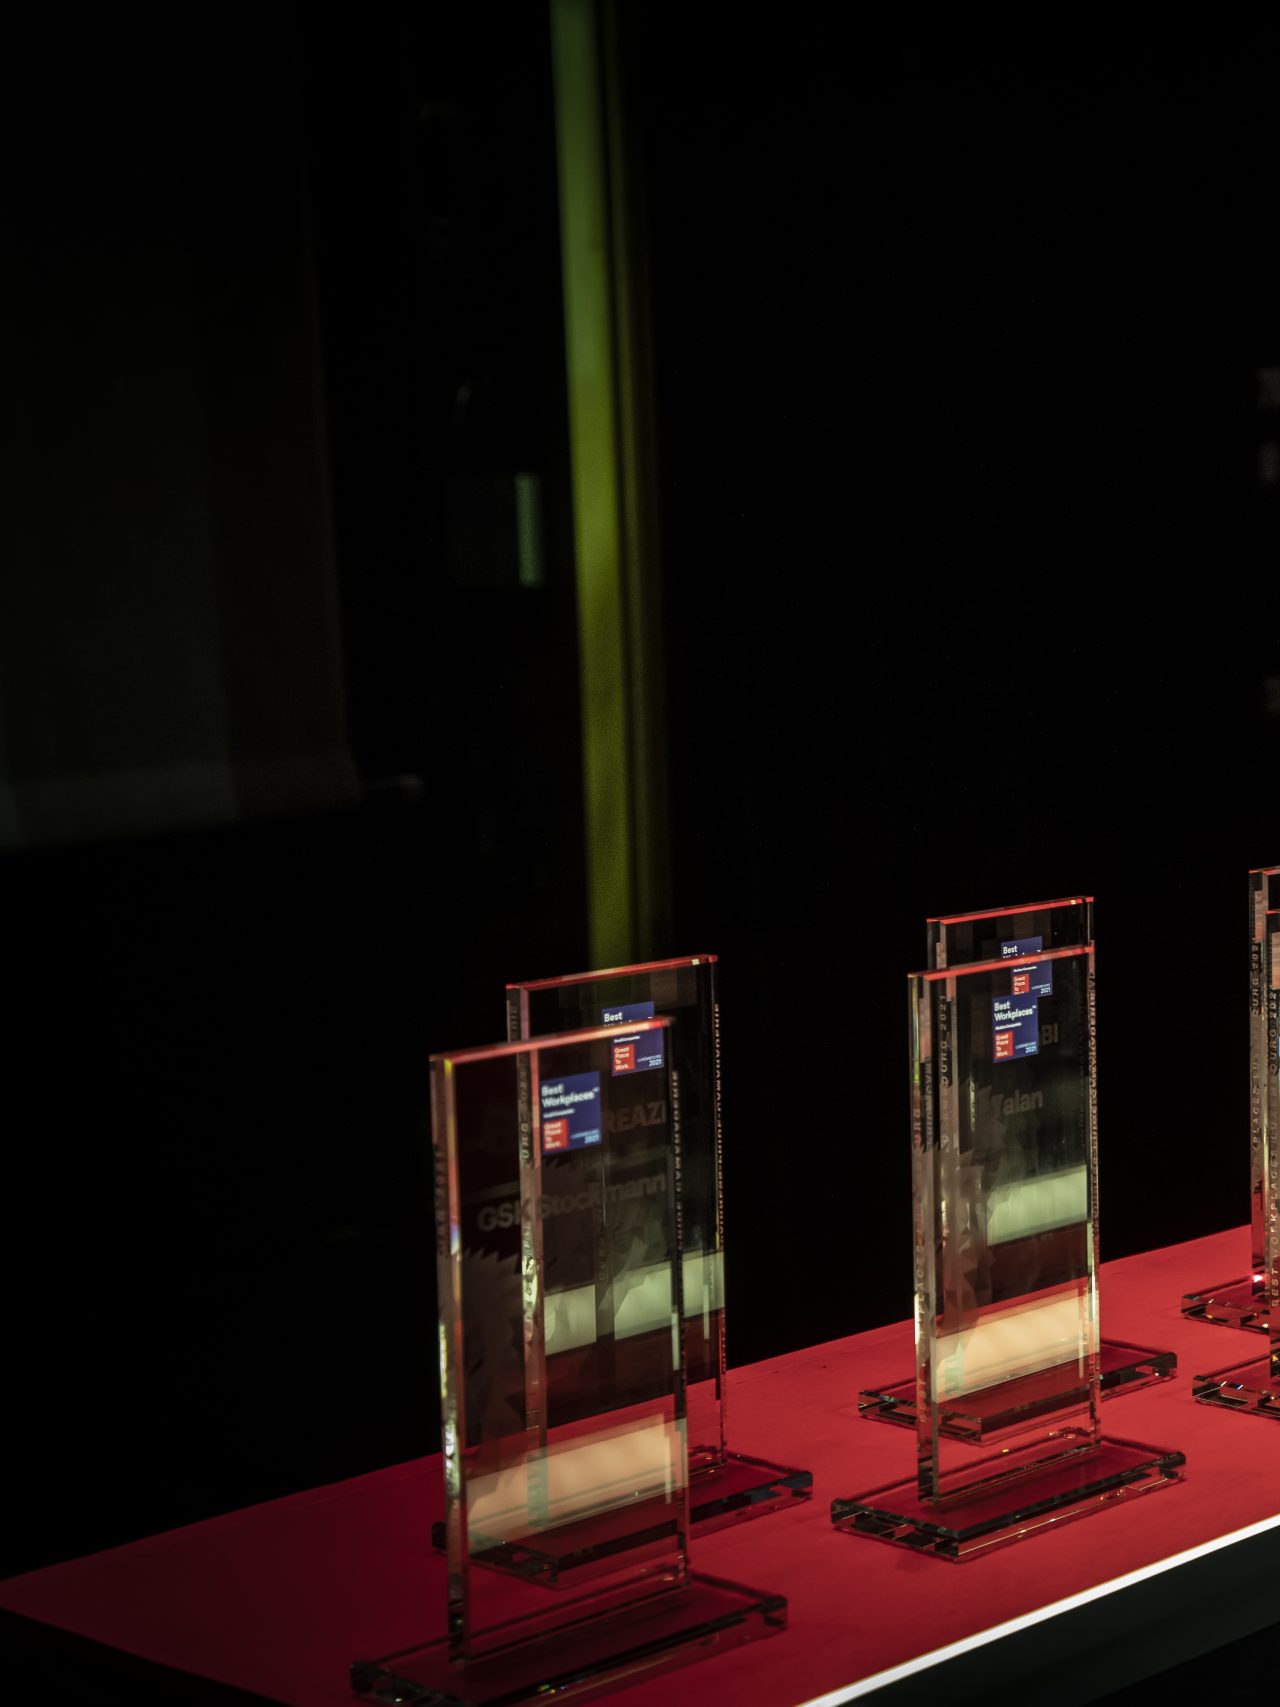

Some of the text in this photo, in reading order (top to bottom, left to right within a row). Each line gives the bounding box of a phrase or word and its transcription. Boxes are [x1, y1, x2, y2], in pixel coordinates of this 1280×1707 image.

[1002, 945, 1018, 955] Best
[994, 1001, 1011, 1012] Best
[603, 1011, 623, 1023] Best
[994, 1008, 1033, 1022] Workplaces
[649, 1059, 662, 1067] 2021
[541, 1083, 565, 1097] Best
[541, 1091, 596, 1108] Workplaces
[991, 1089, 1044, 1118] Talan
[475, 1199, 531, 1232] GSK
